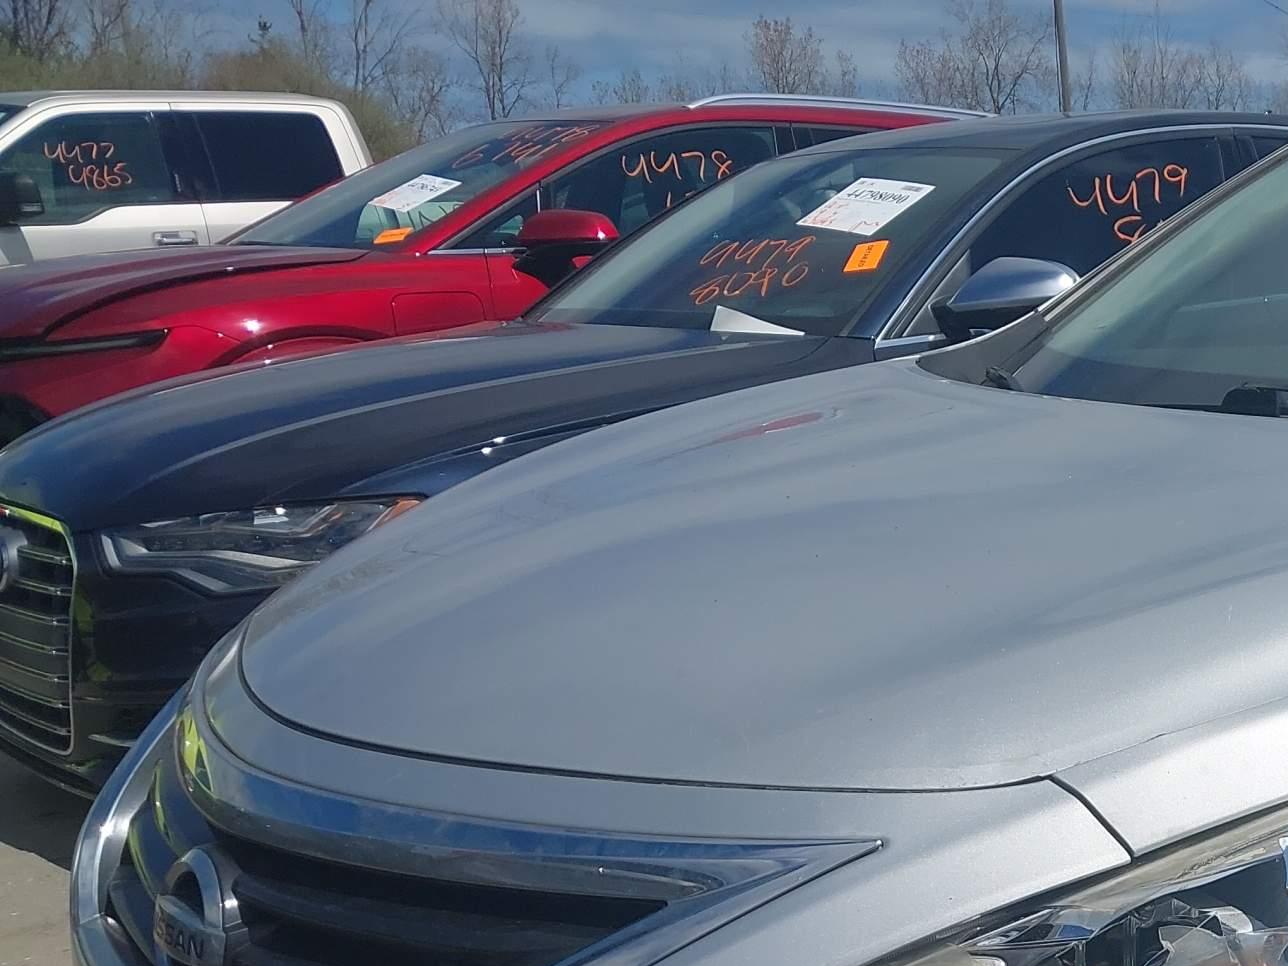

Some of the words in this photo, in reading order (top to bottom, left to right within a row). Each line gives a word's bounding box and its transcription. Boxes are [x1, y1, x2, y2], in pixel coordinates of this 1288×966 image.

[43, 141, 115, 164] 4477
[621, 150, 733, 184] 4478
[68, 162, 133, 192] 4865
[1066, 163, 1188, 215] 4479
